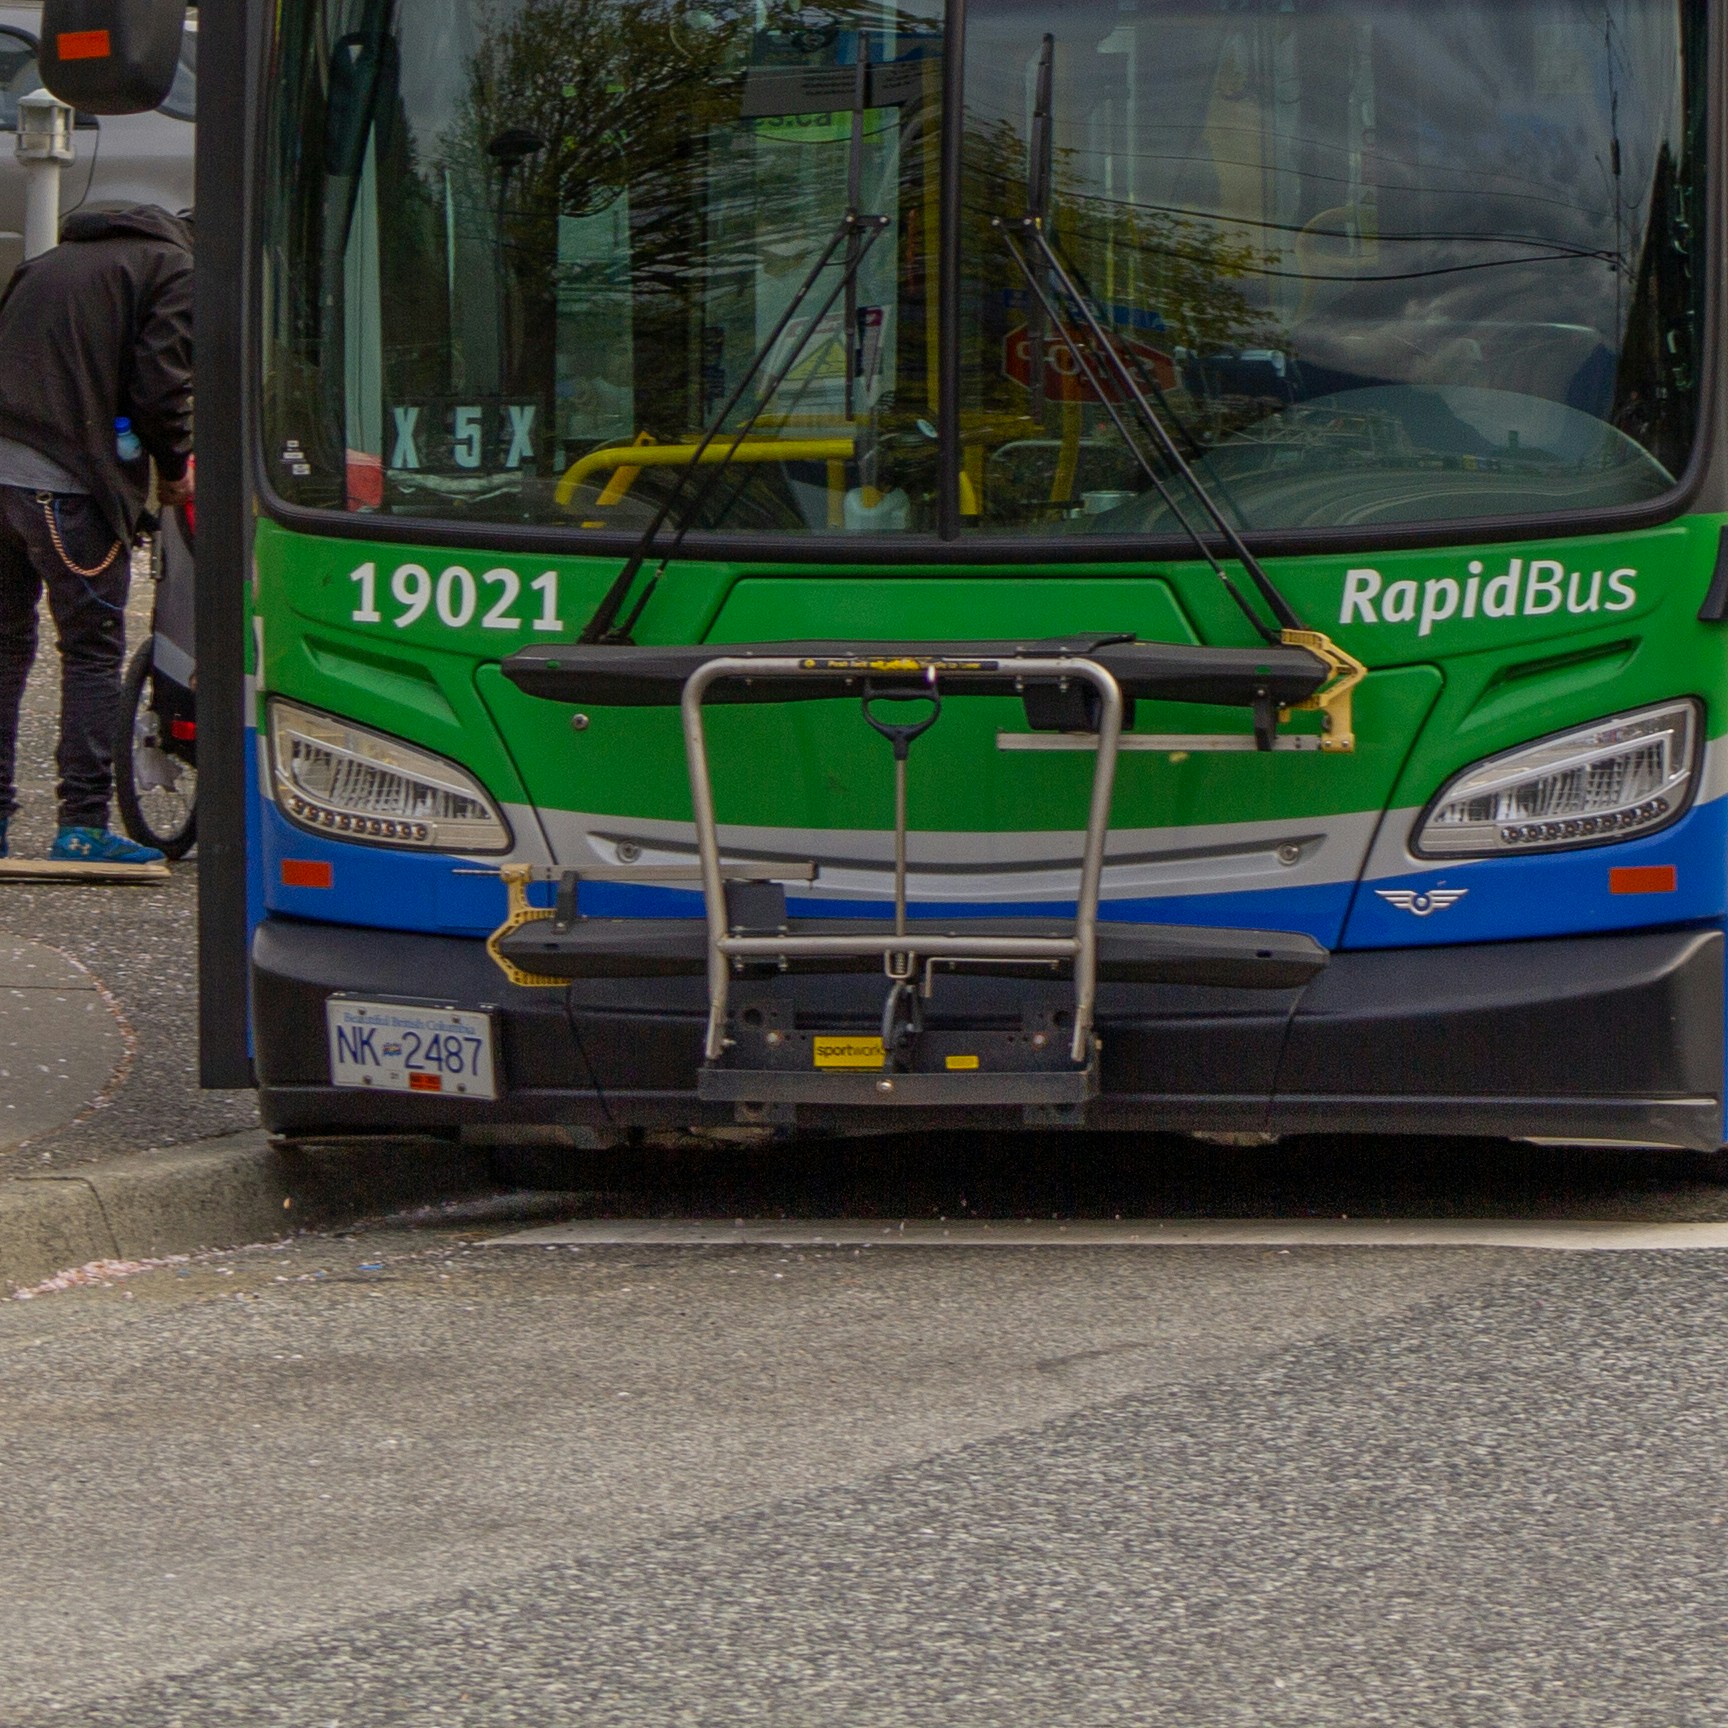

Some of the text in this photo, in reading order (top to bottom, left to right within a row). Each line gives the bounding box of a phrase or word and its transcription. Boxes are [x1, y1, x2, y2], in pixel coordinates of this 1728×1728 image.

[391, 405, 536, 469] X 5 X
[350, 562, 564, 632] 19021
[1339, 558, 1638, 637] RapidBus
[337, 1025, 482, 1076] NK 2487
